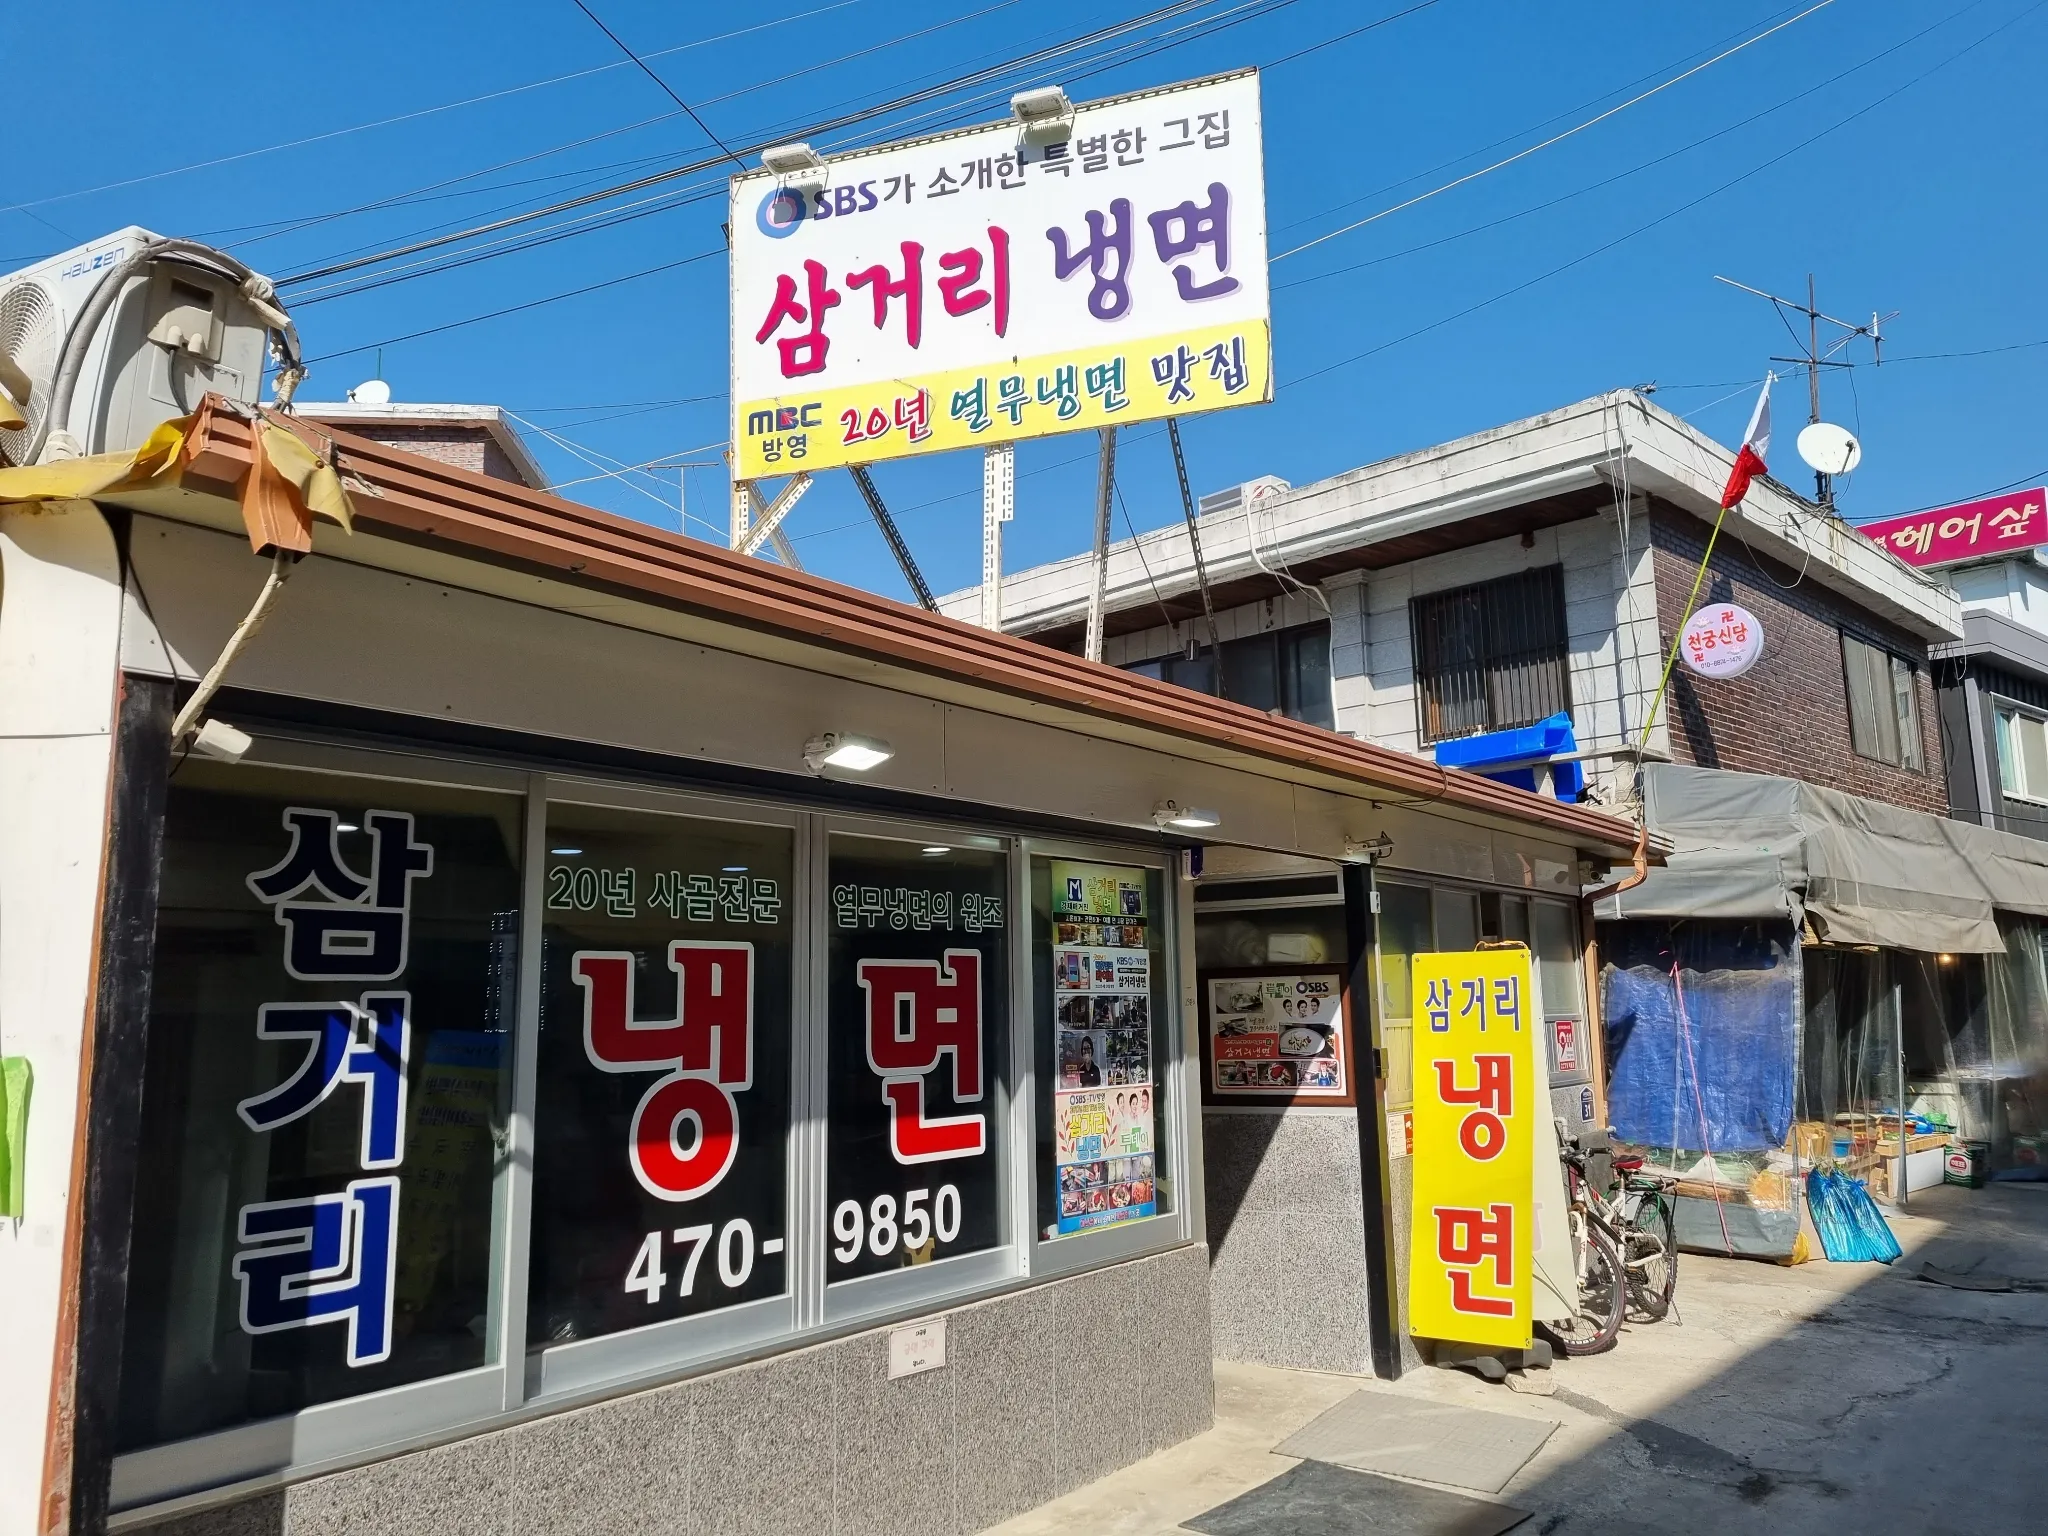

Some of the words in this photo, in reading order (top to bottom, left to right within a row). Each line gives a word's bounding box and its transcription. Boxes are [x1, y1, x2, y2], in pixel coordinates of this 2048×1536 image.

[814, 174, 916, 220] SBS가
[926, 145, 1029, 198] 소개한
[1039, 127, 1146, 178] 특별한
[1158, 109, 1231, 152] 그집
[755, 225, 1010, 379] 삼거리
[1046, 181, 1244, 322] 냉면
[839, 388, 932, 446] 20년
[949, 355, 1130, 432] 열무냉면
[1150, 336, 1250, 402] 맛집
[748, 402, 823, 436] MBC
[762, 433, 808, 463] 방영
[1688, 622, 1748, 651] 천궁신당
[547, 866, 636, 913] 20년
[647, 869, 783, 925] 사골전문
[1087, 876, 1117, 898] 삼거리
[832, 884, 954, 932] 열무냉면의
[960, 894, 1004, 933] 원조
[1092, 895, 1112, 914] 냉면
[1118, 975, 1146, 988] 삼거리냉면
[1308, 981, 1329, 993] SBS
[1424, 974, 1521, 1033] 삼거리
[232, 806, 434, 1368] 삼거리
[1069, 1111, 1106, 1138] 삼거리
[1076, 1135, 1101, 1160] 냉면
